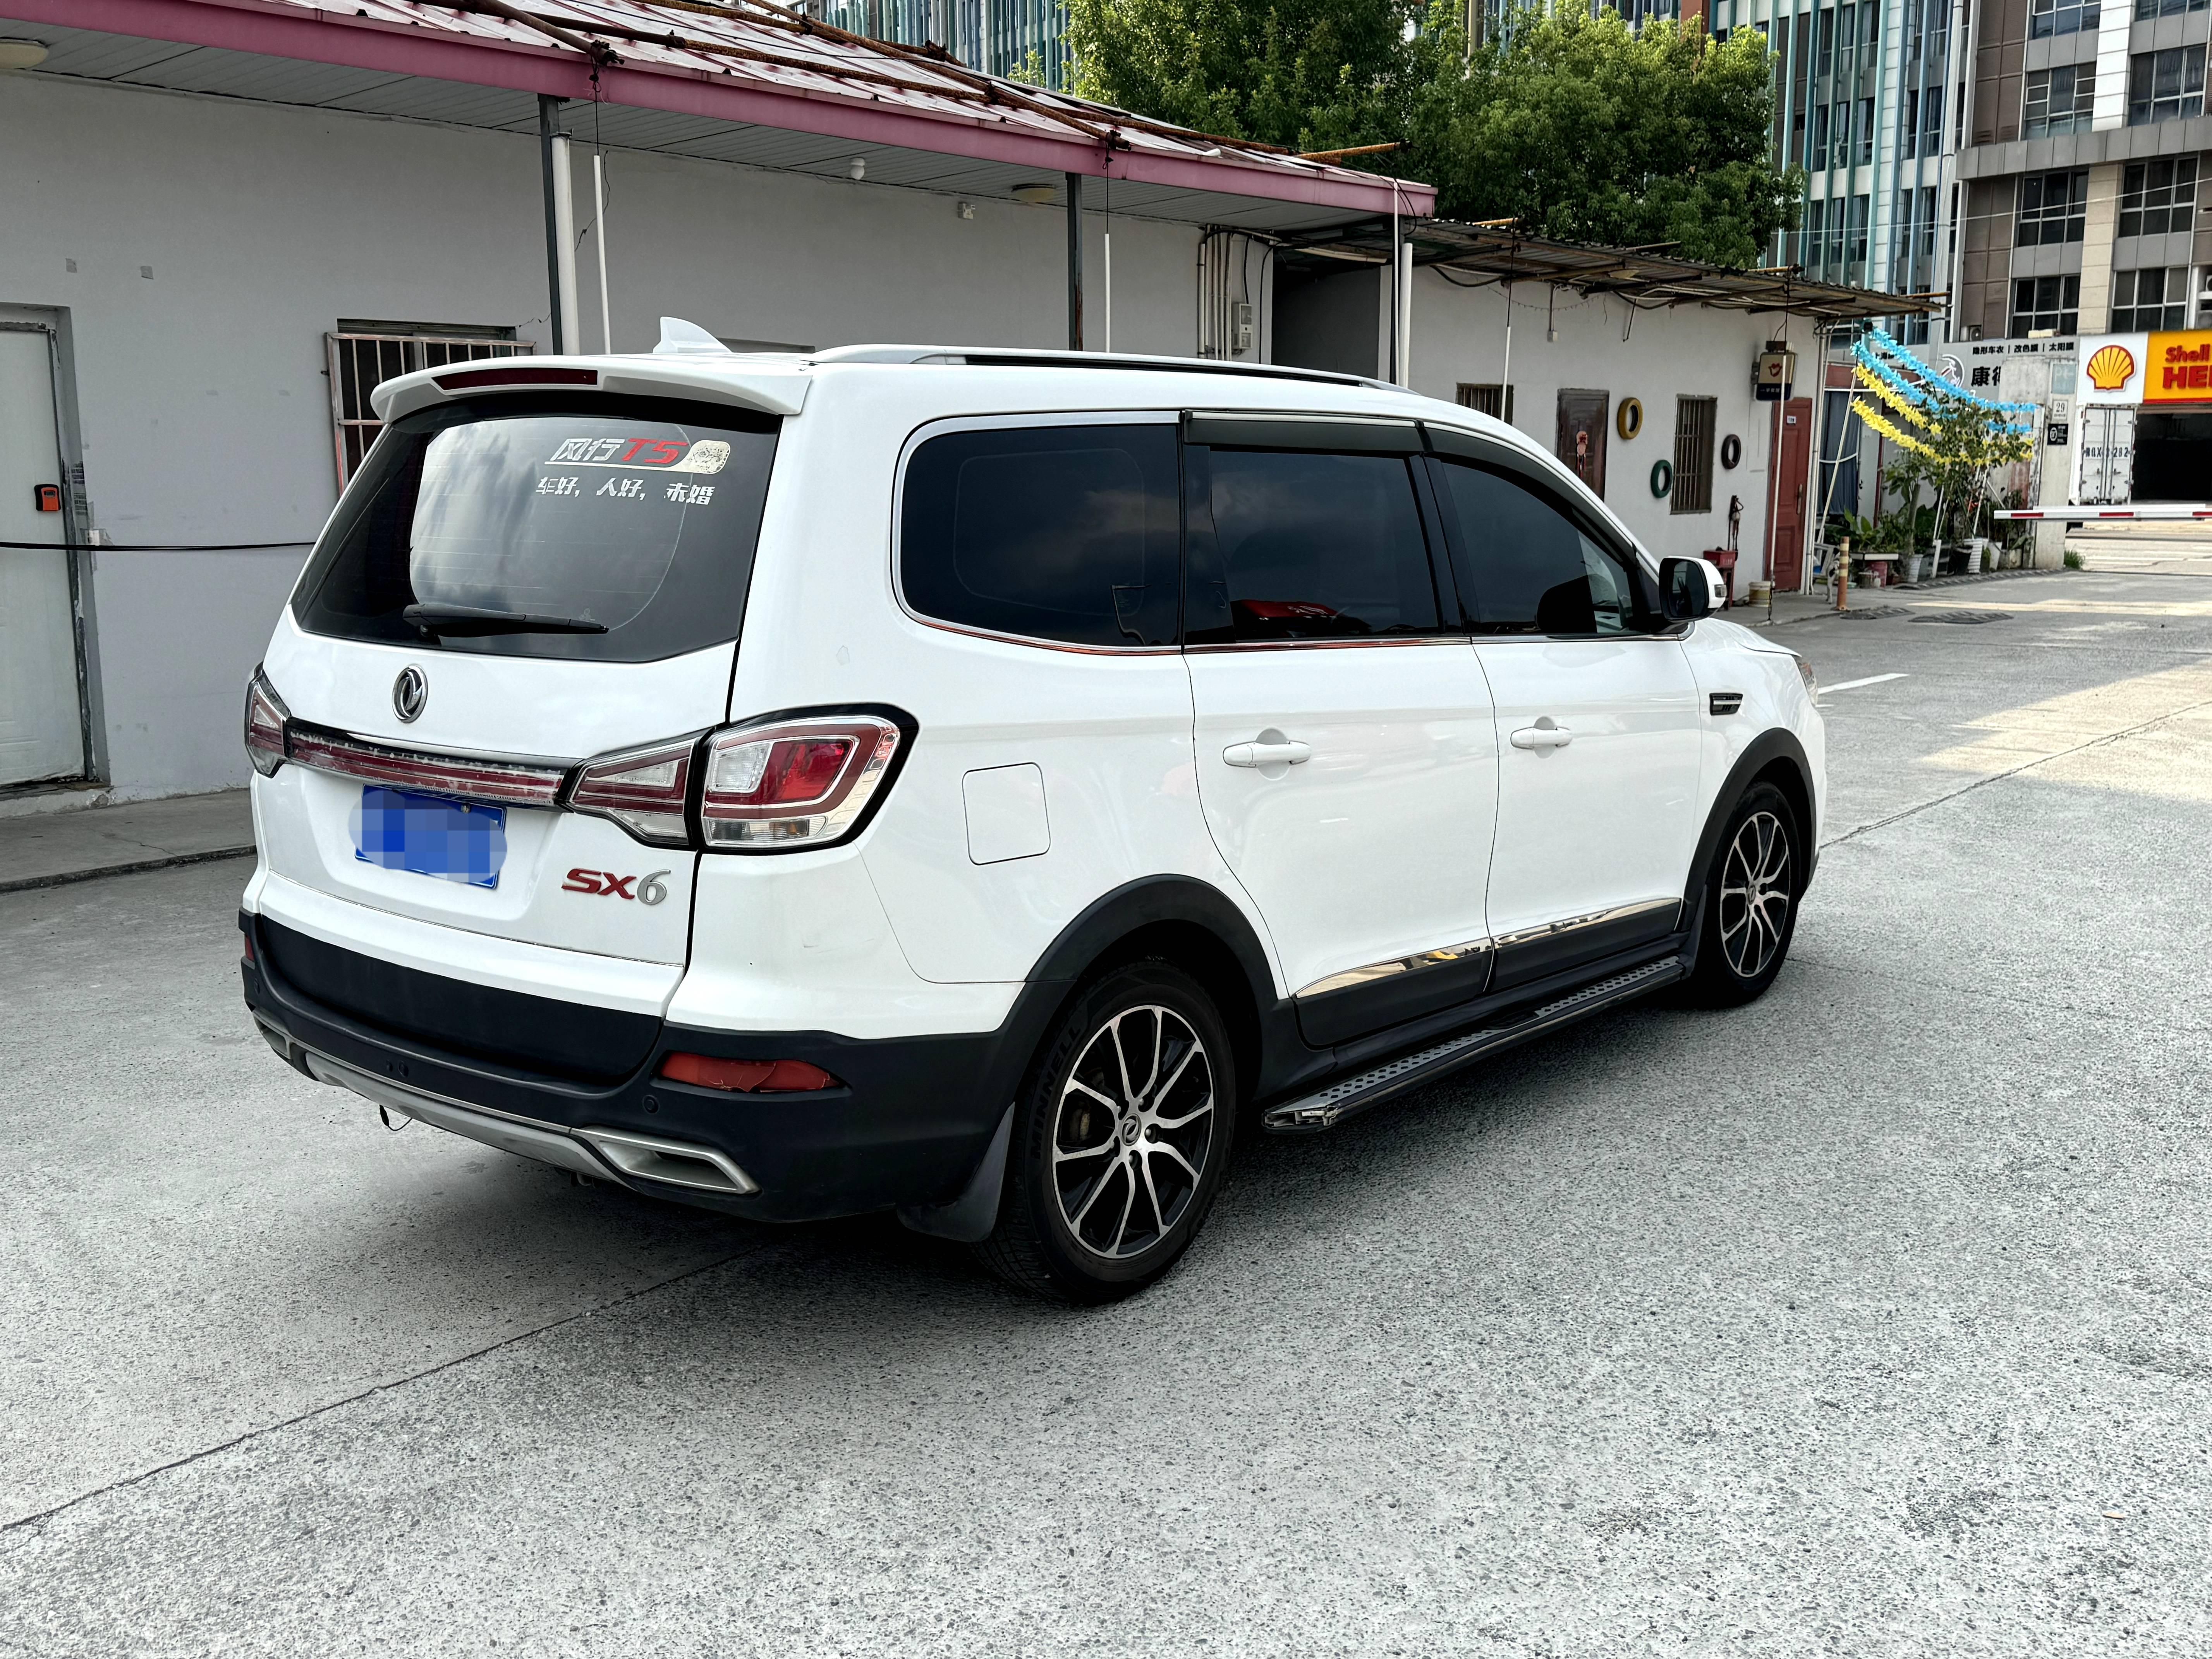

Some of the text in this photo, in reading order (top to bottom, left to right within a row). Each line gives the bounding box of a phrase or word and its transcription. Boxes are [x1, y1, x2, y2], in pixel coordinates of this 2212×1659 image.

[2165, 344, 2210, 362] Shell
[2162, 365, 2212, 389] HE
[2056, 402, 2065, 412] 29
[561, 867, 672, 906] SX6
[1030, 1024, 1082, 1161] MINNELL
